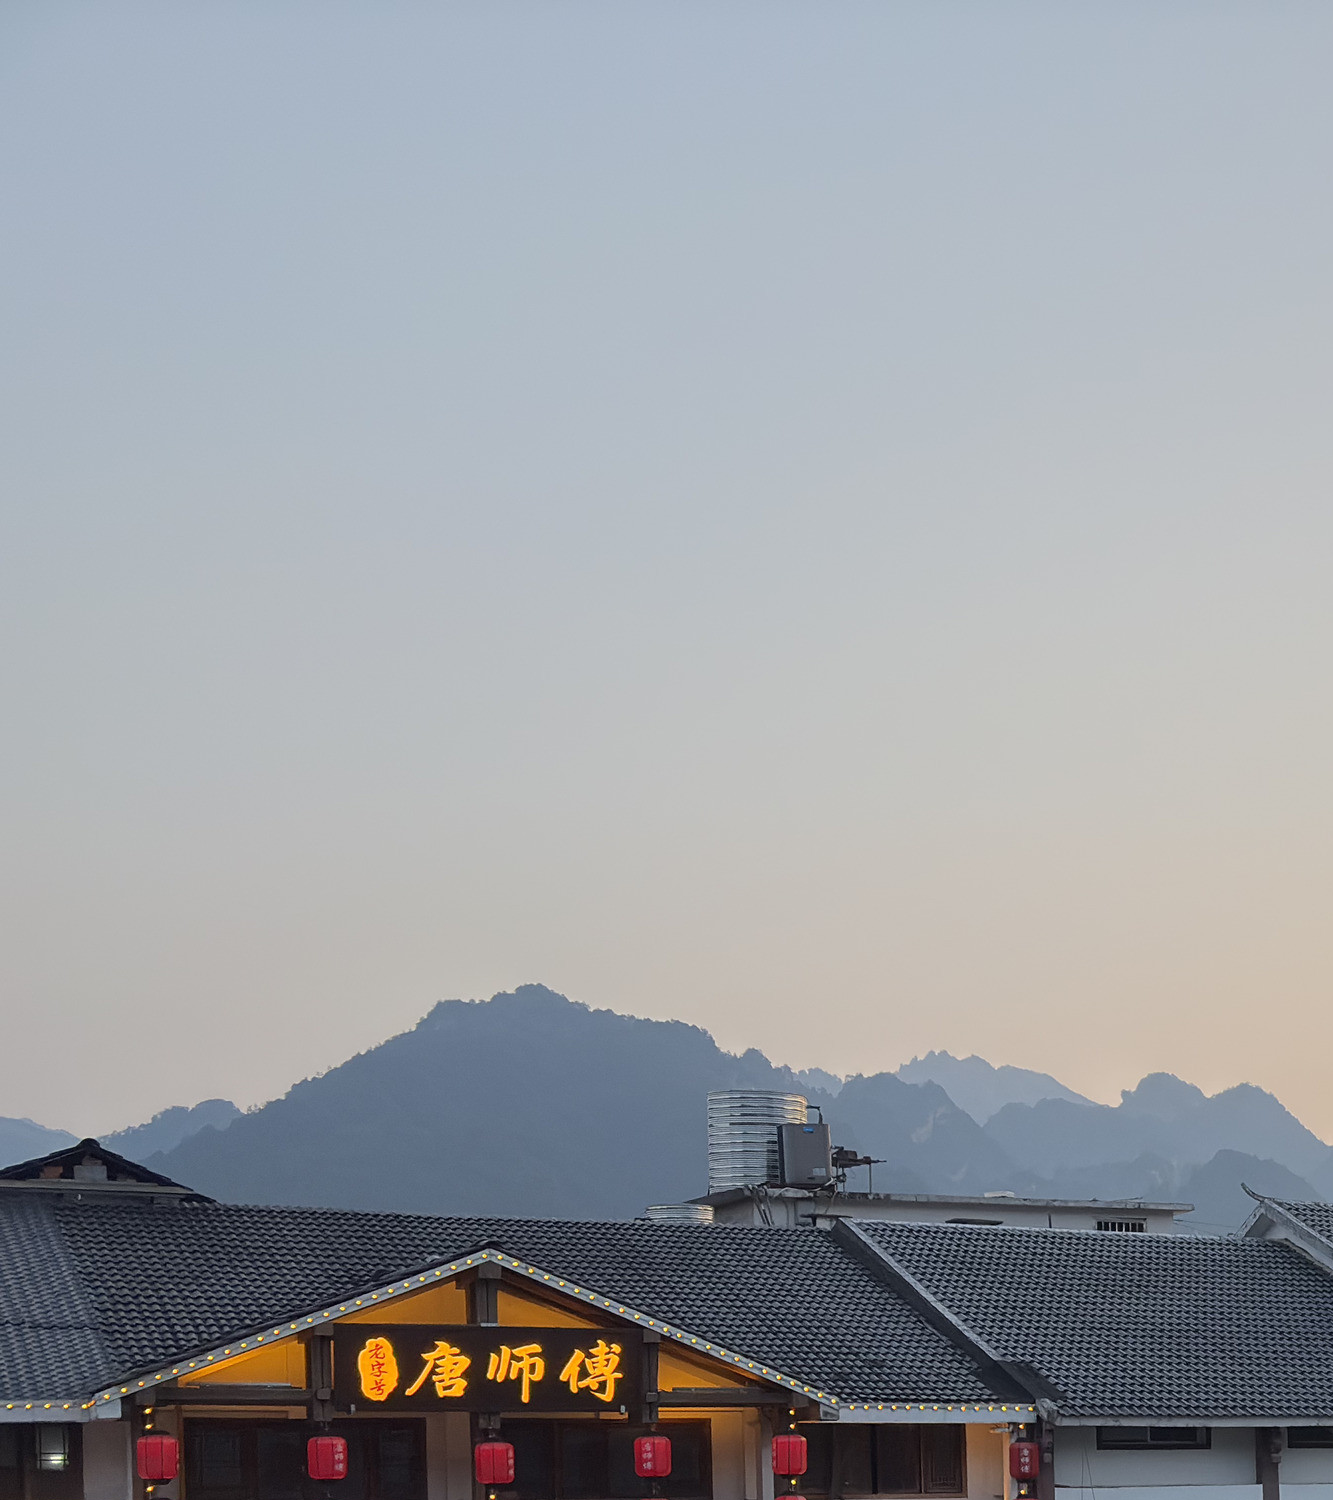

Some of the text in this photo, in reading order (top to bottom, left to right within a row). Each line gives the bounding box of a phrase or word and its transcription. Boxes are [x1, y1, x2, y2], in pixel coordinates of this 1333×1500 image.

[369, 1343, 386, 1396] 老字号
[405, 1341, 623, 1403] 唐师傅
